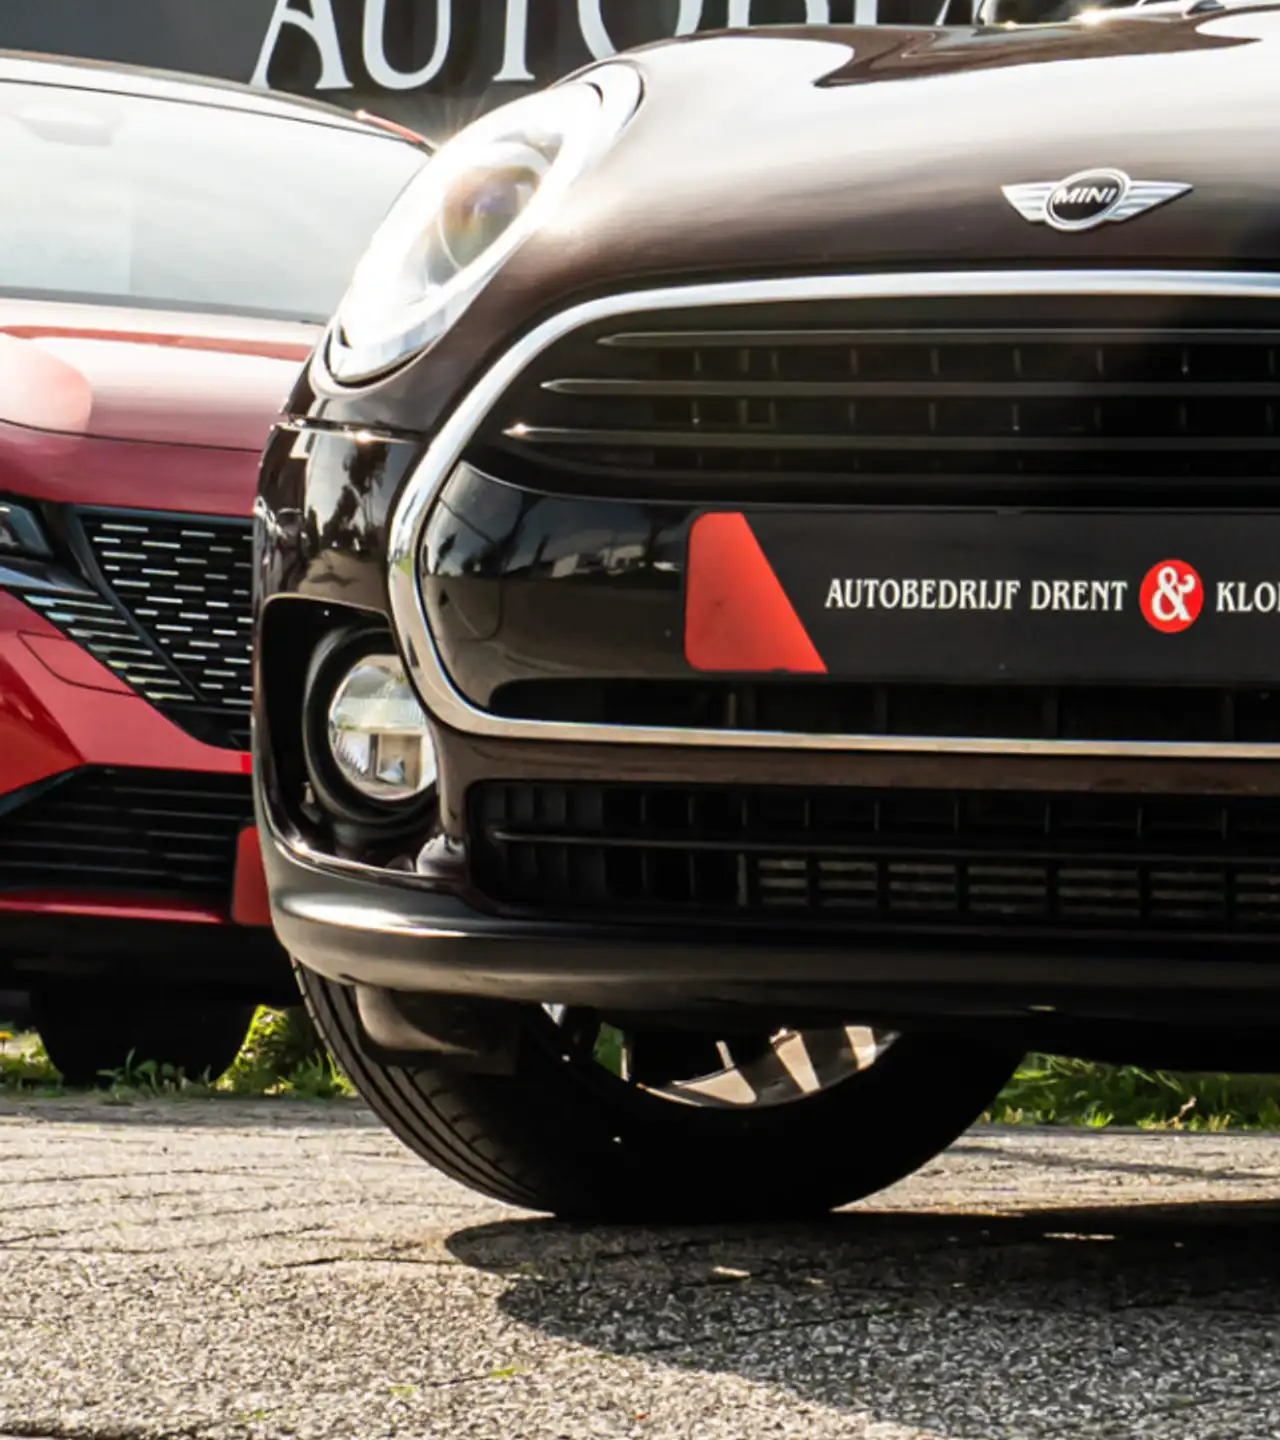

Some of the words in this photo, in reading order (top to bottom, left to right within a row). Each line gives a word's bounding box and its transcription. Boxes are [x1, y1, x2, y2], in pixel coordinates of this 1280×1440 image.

[1053, 186, 1117, 205] MINI
[825, 578, 1020, 610] AUTOBEDRIJF
[1030, 580, 1128, 612] DRENT
[1150, 566, 1195, 622] &
